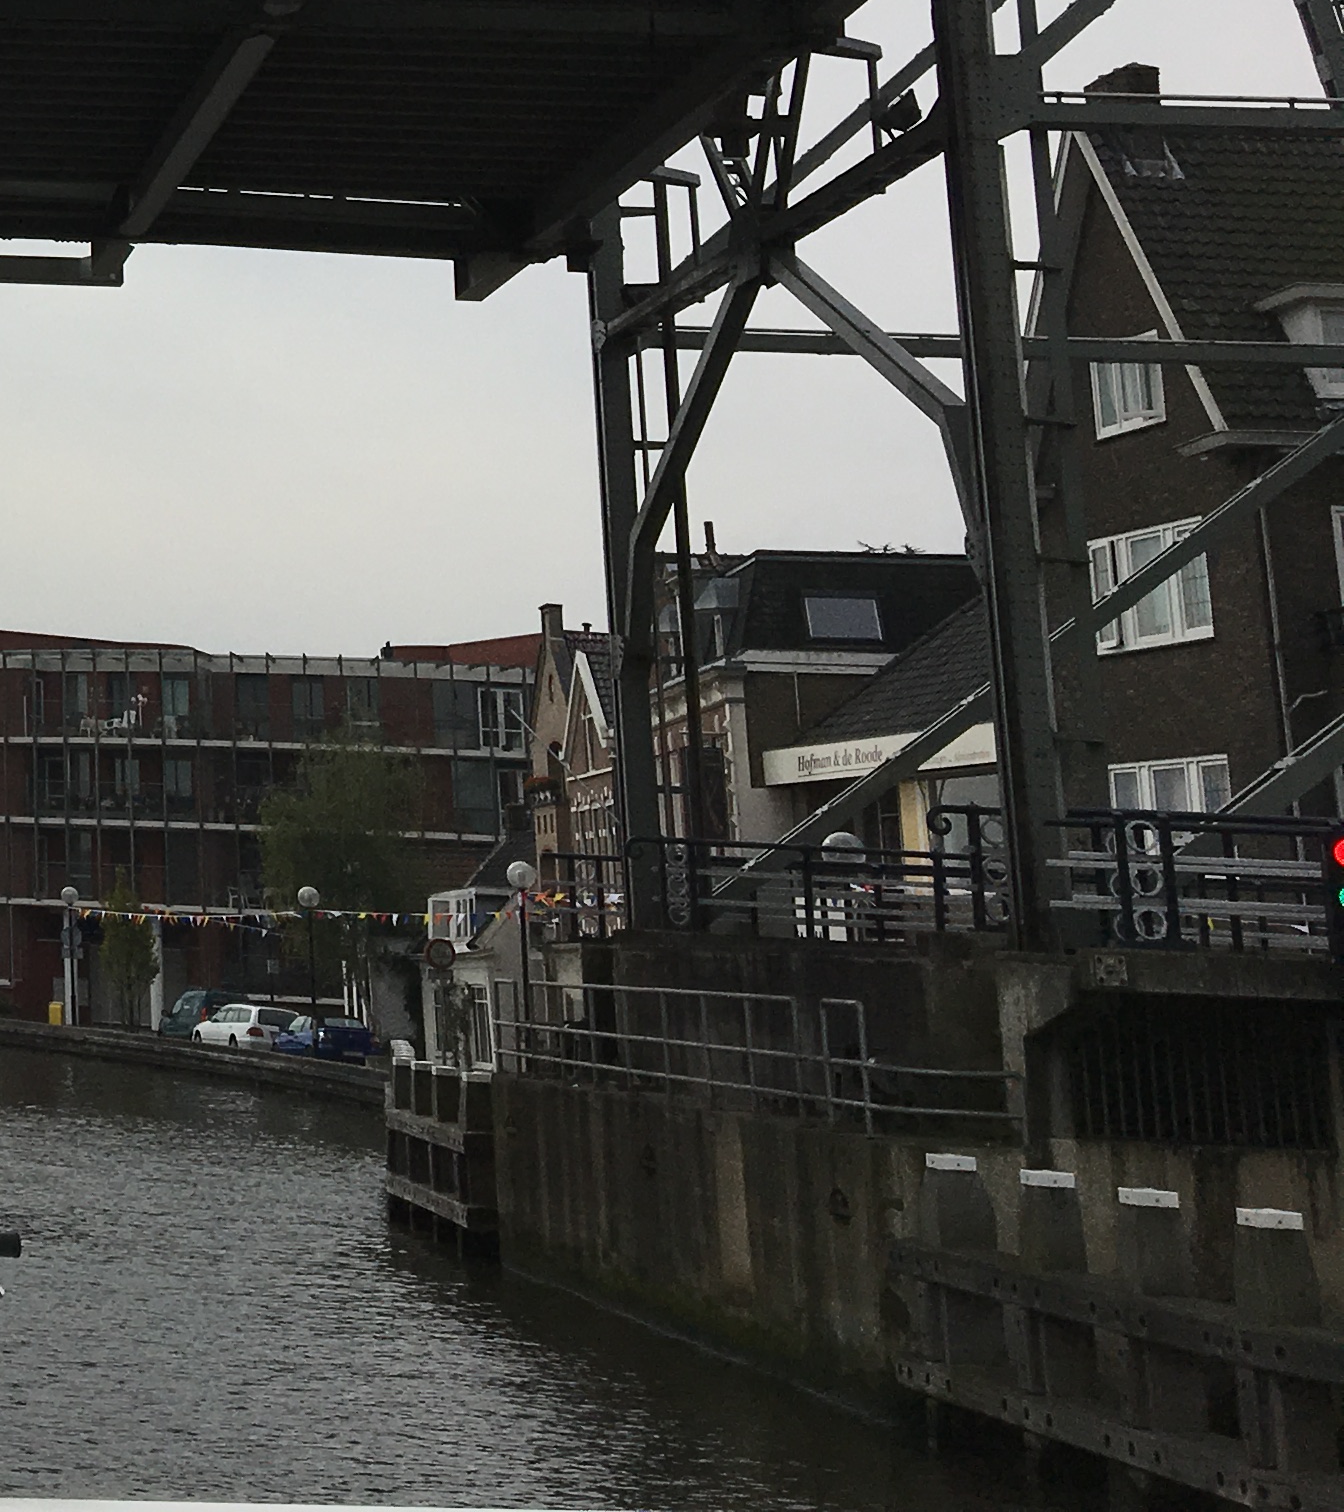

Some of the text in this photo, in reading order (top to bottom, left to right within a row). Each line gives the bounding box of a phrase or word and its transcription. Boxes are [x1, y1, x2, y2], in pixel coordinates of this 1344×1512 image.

[798, 745, 882, 774] Hofman & de Roode
